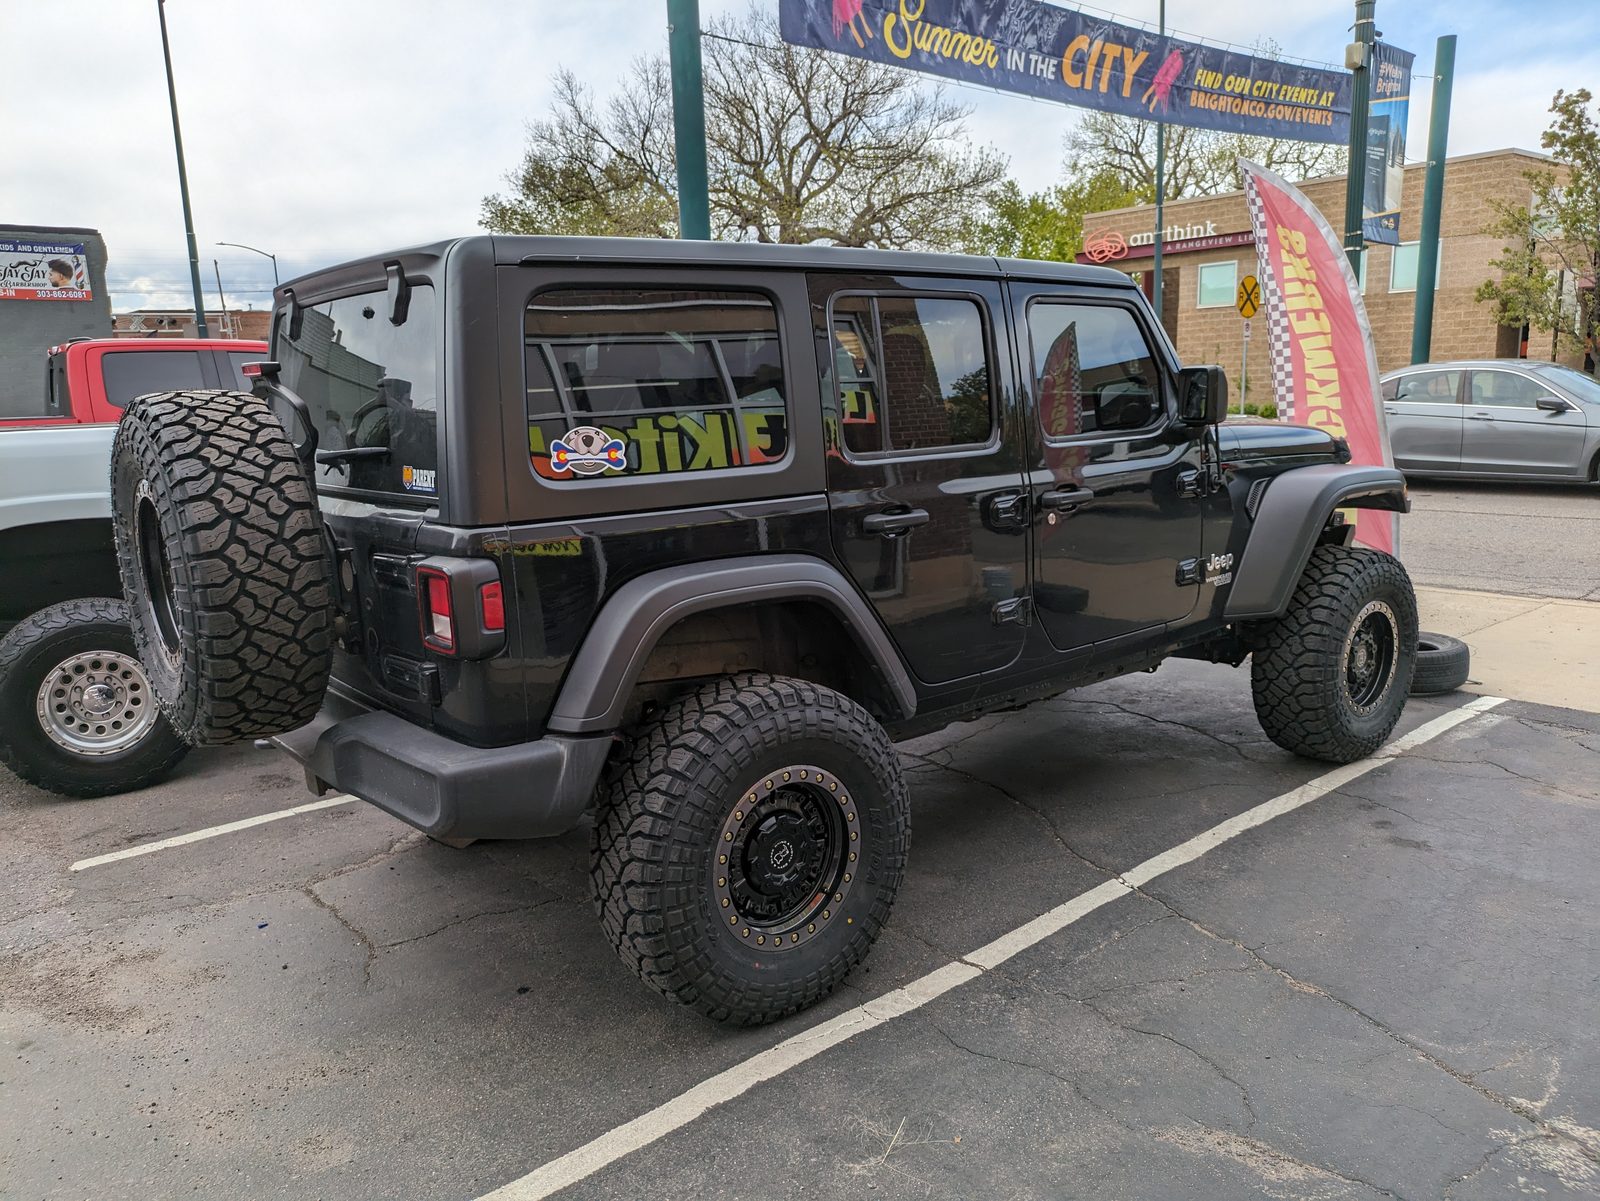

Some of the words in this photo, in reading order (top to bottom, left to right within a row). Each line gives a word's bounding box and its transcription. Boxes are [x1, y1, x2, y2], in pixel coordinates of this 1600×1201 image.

[884, 0, 998, 69] Summer
[1007, 48, 1025, 74] IN
[1029, 53, 1058, 80] THE
[1061, 35, 1149, 97] CITY
[1194, 69, 1223, 89] FIND
[1224, 74, 1251, 95] OUR
[1252, 80, 1279, 99] CITY
[1279, 85, 1319, 105] EVENTS
[1319, 91, 1335, 107] AT
[1190, 90, 1333, 126] BRIGHTONCO.GOV/EVENTS
[1129, 220, 1217, 247] anthink
[1175, 236, 1233, 250] RANGEVIEW
[17, 244, 32, 252] AND
[33, 246, 74, 254] GENTLEMEN
[1206, 553, 1234, 571] Jeep
